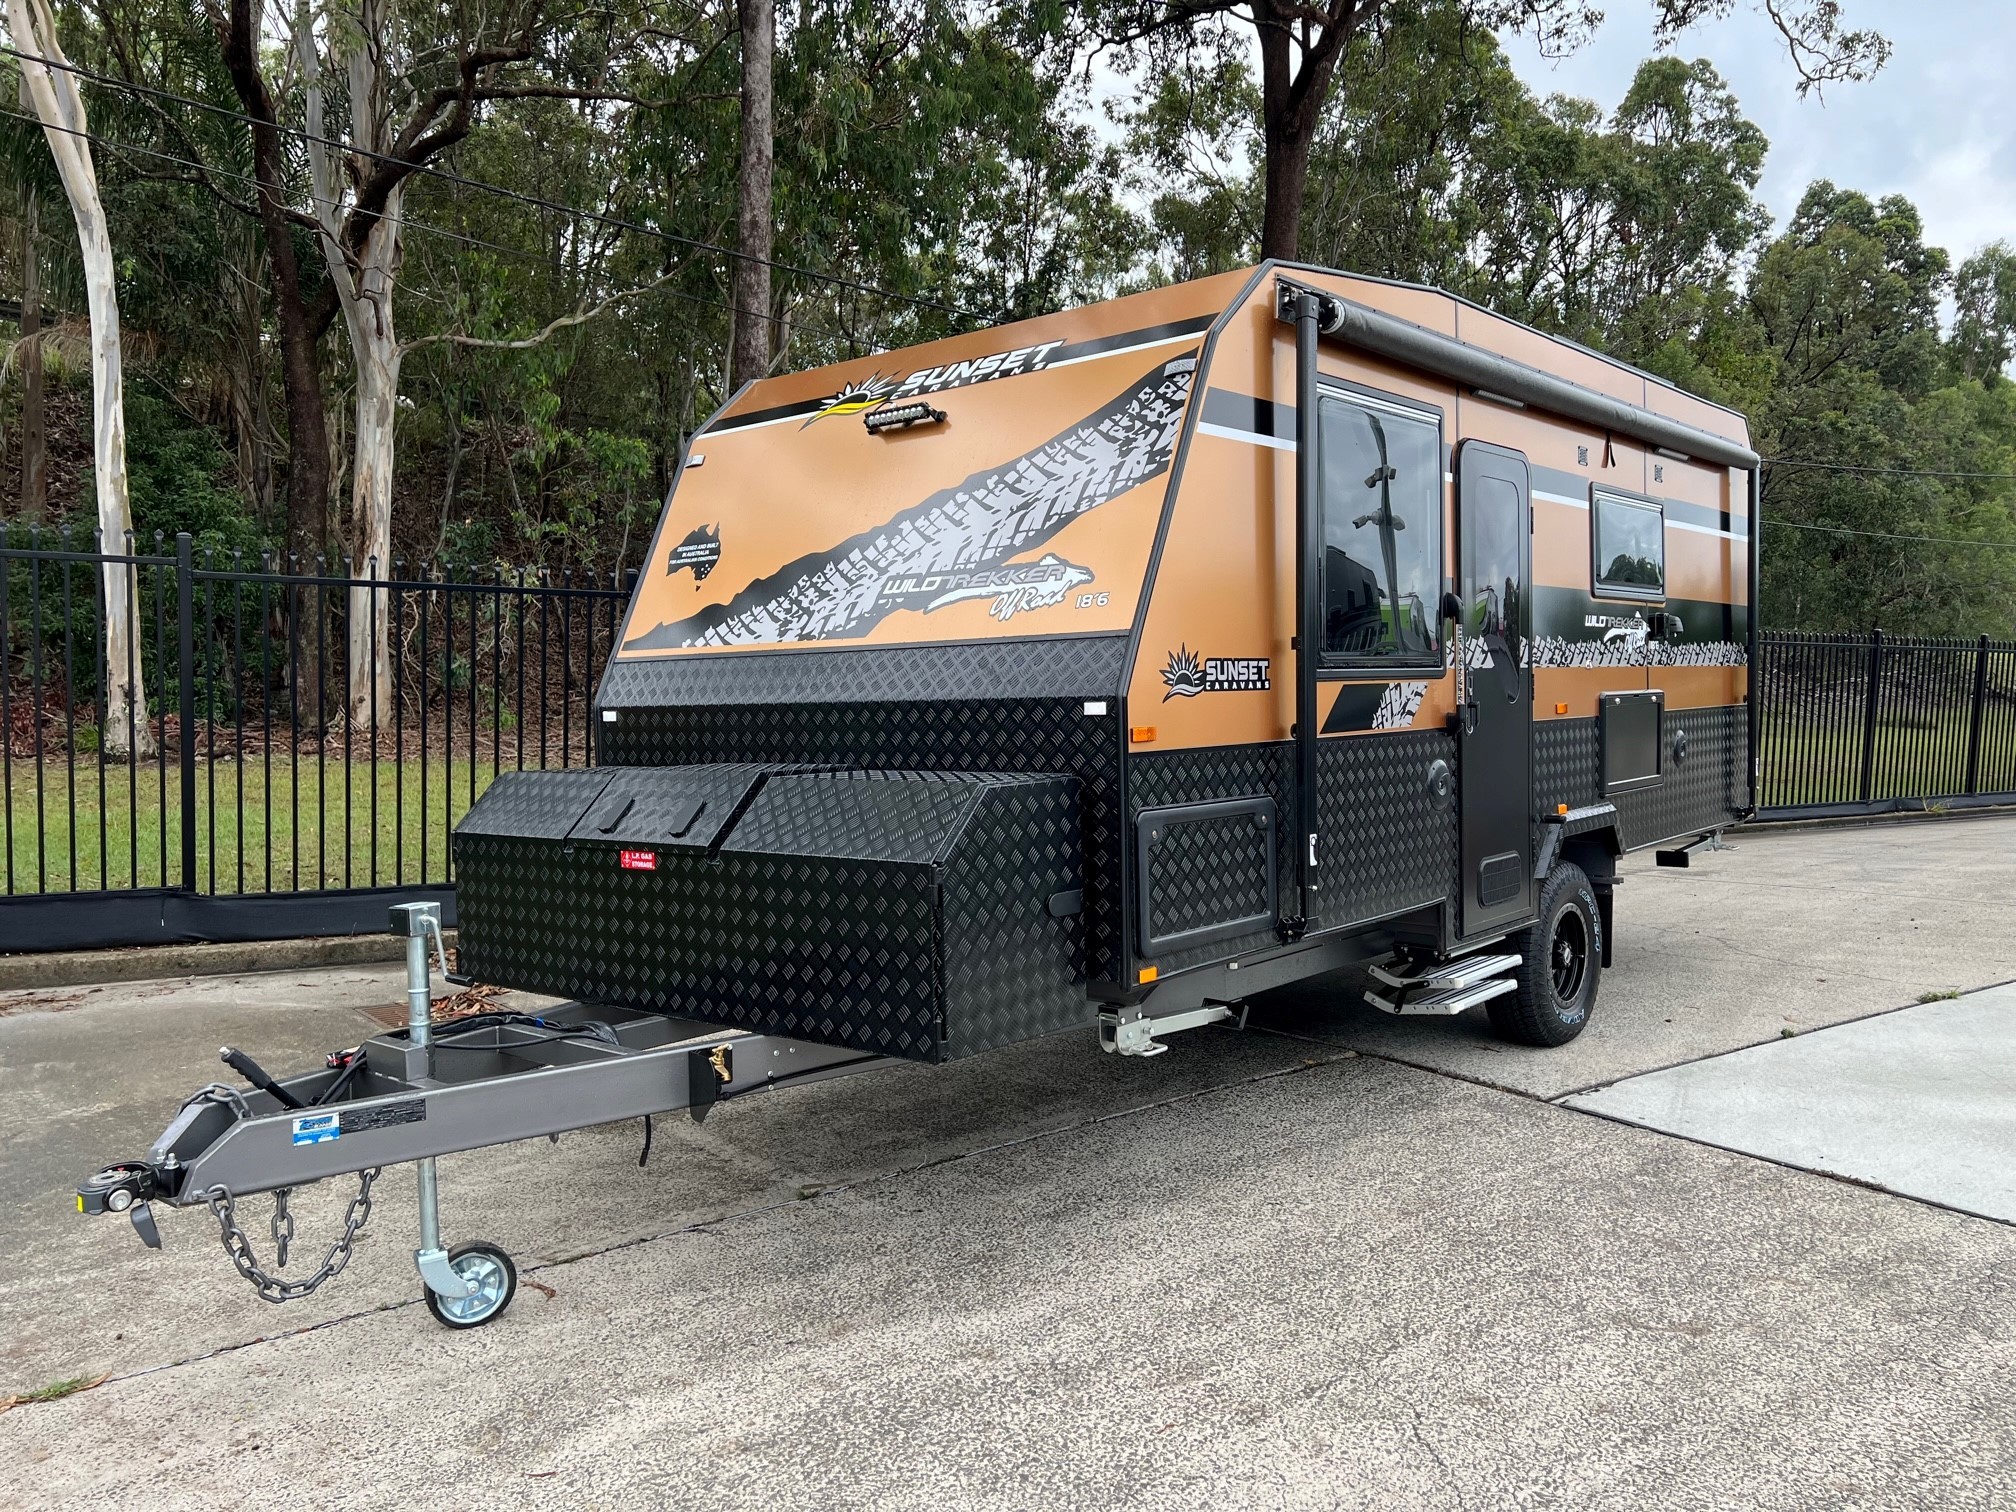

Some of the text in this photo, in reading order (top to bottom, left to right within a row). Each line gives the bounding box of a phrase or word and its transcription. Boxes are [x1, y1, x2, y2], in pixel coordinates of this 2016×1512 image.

[896, 339, 1065, 393] SUNSET
[889, 361, 1048, 400] CARAVANS
[882, 564, 1066, 595] WILDTREKKER
[1584, 614, 1644, 630] WILDTREKKER
[1205, 660, 1269, 681] SUNSET
[1205, 681, 1270, 690] CARAVANS
